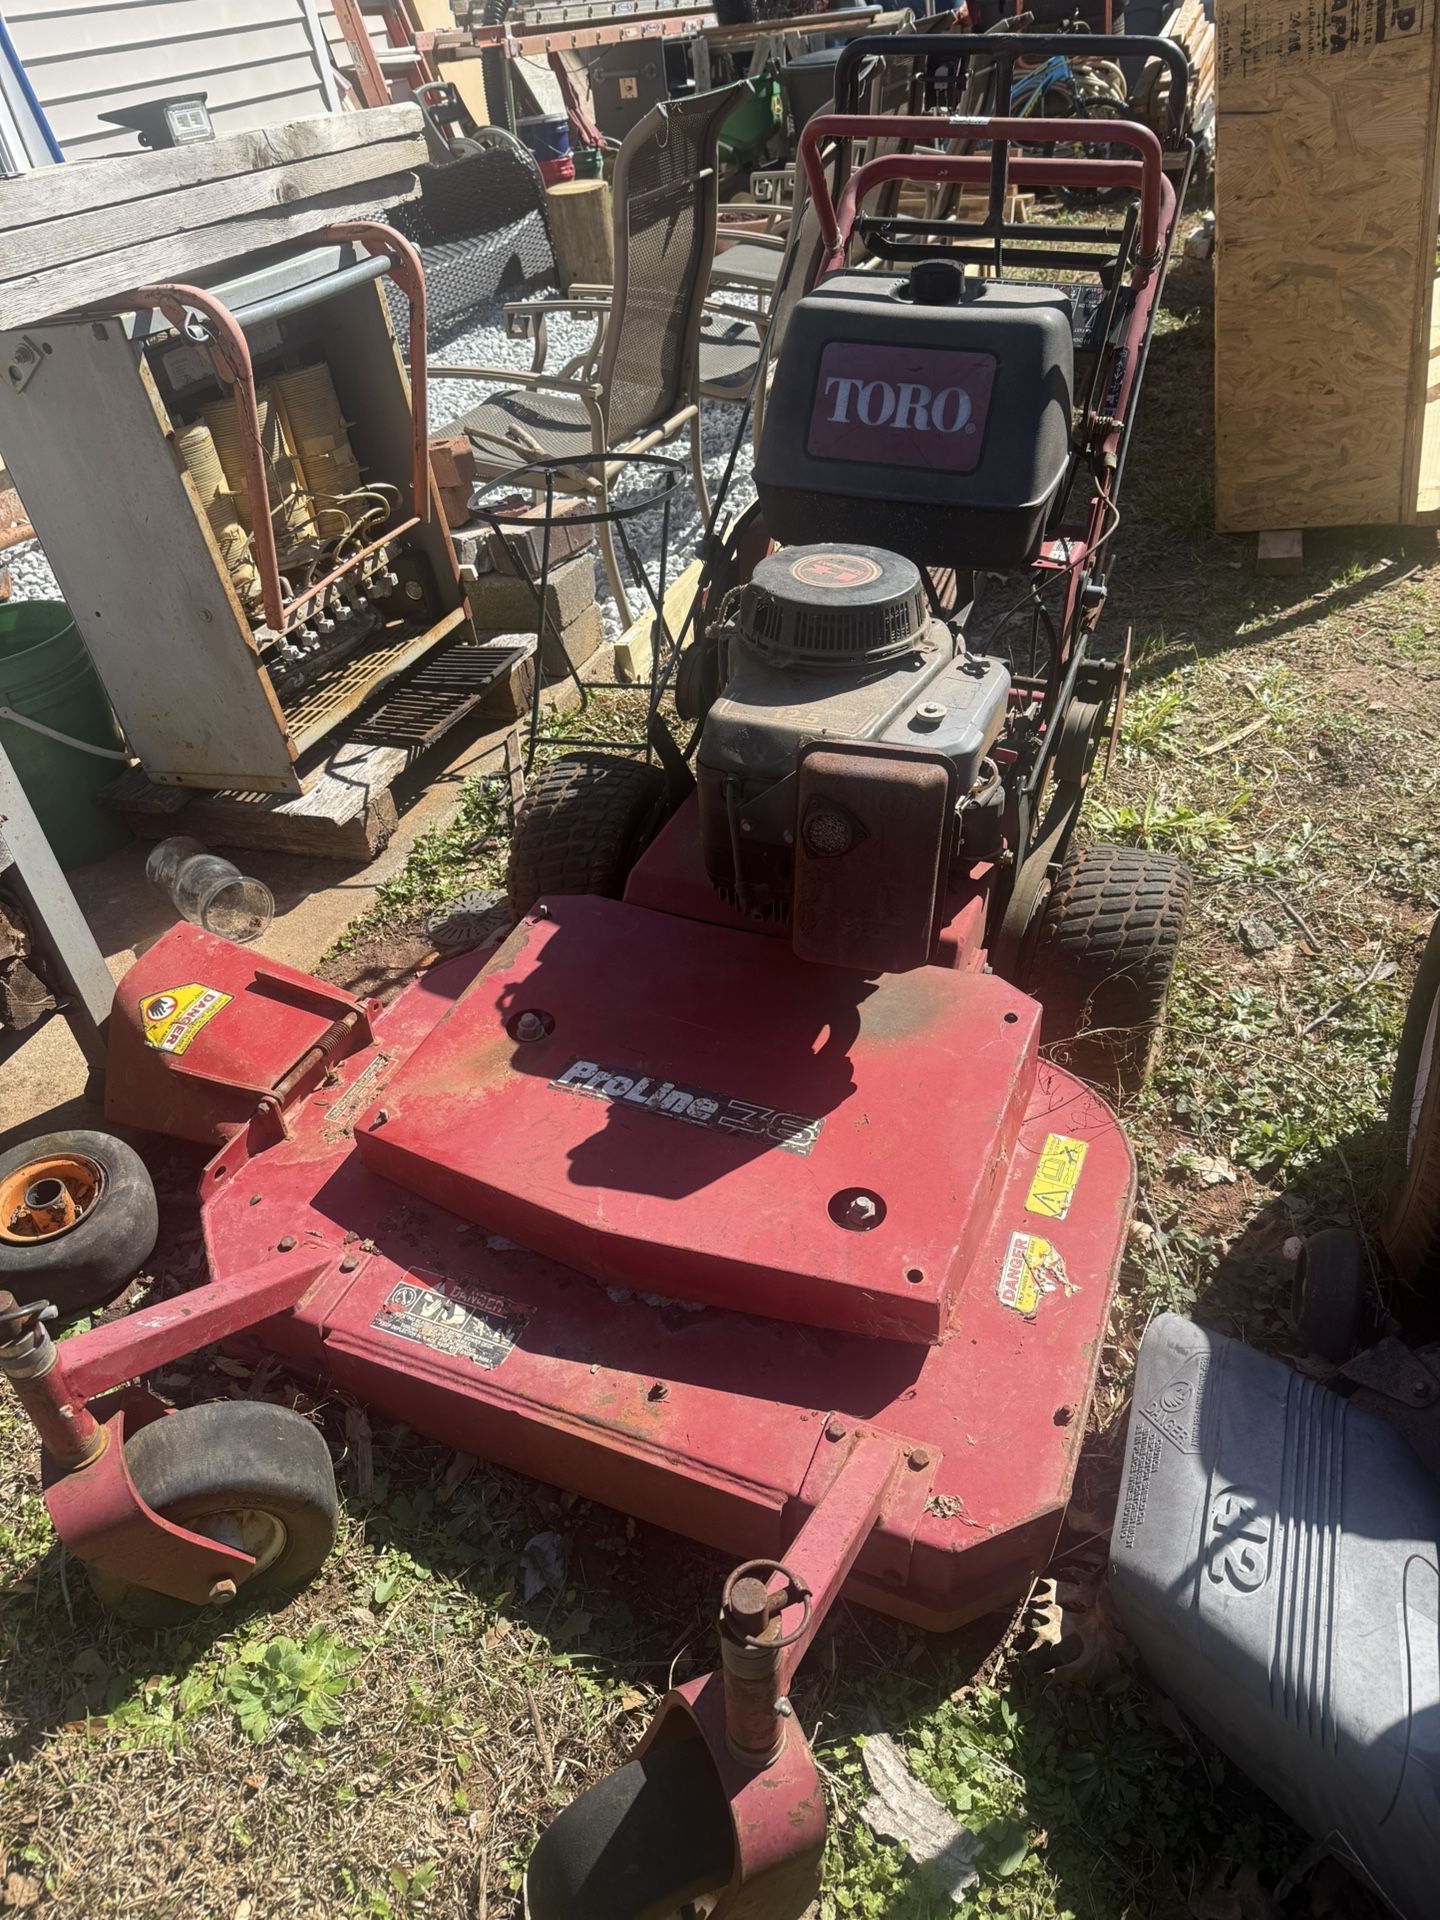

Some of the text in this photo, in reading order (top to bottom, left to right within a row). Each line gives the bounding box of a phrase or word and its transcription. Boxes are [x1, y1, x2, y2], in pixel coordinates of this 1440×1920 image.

[825, 377, 972, 432] TORO
[166, 994, 216, 1045] DANGER
[558, 1061, 818, 1145] ProLine 36
[1002, 1238, 1028, 1302] DANGER
[450, 1286, 505, 1313] DANGER
[1145, 1401, 1188, 1445] DANGER
[1151, 1438, 1162, 1473] CAUTION
[1209, 1494, 1268, 1593] 42
